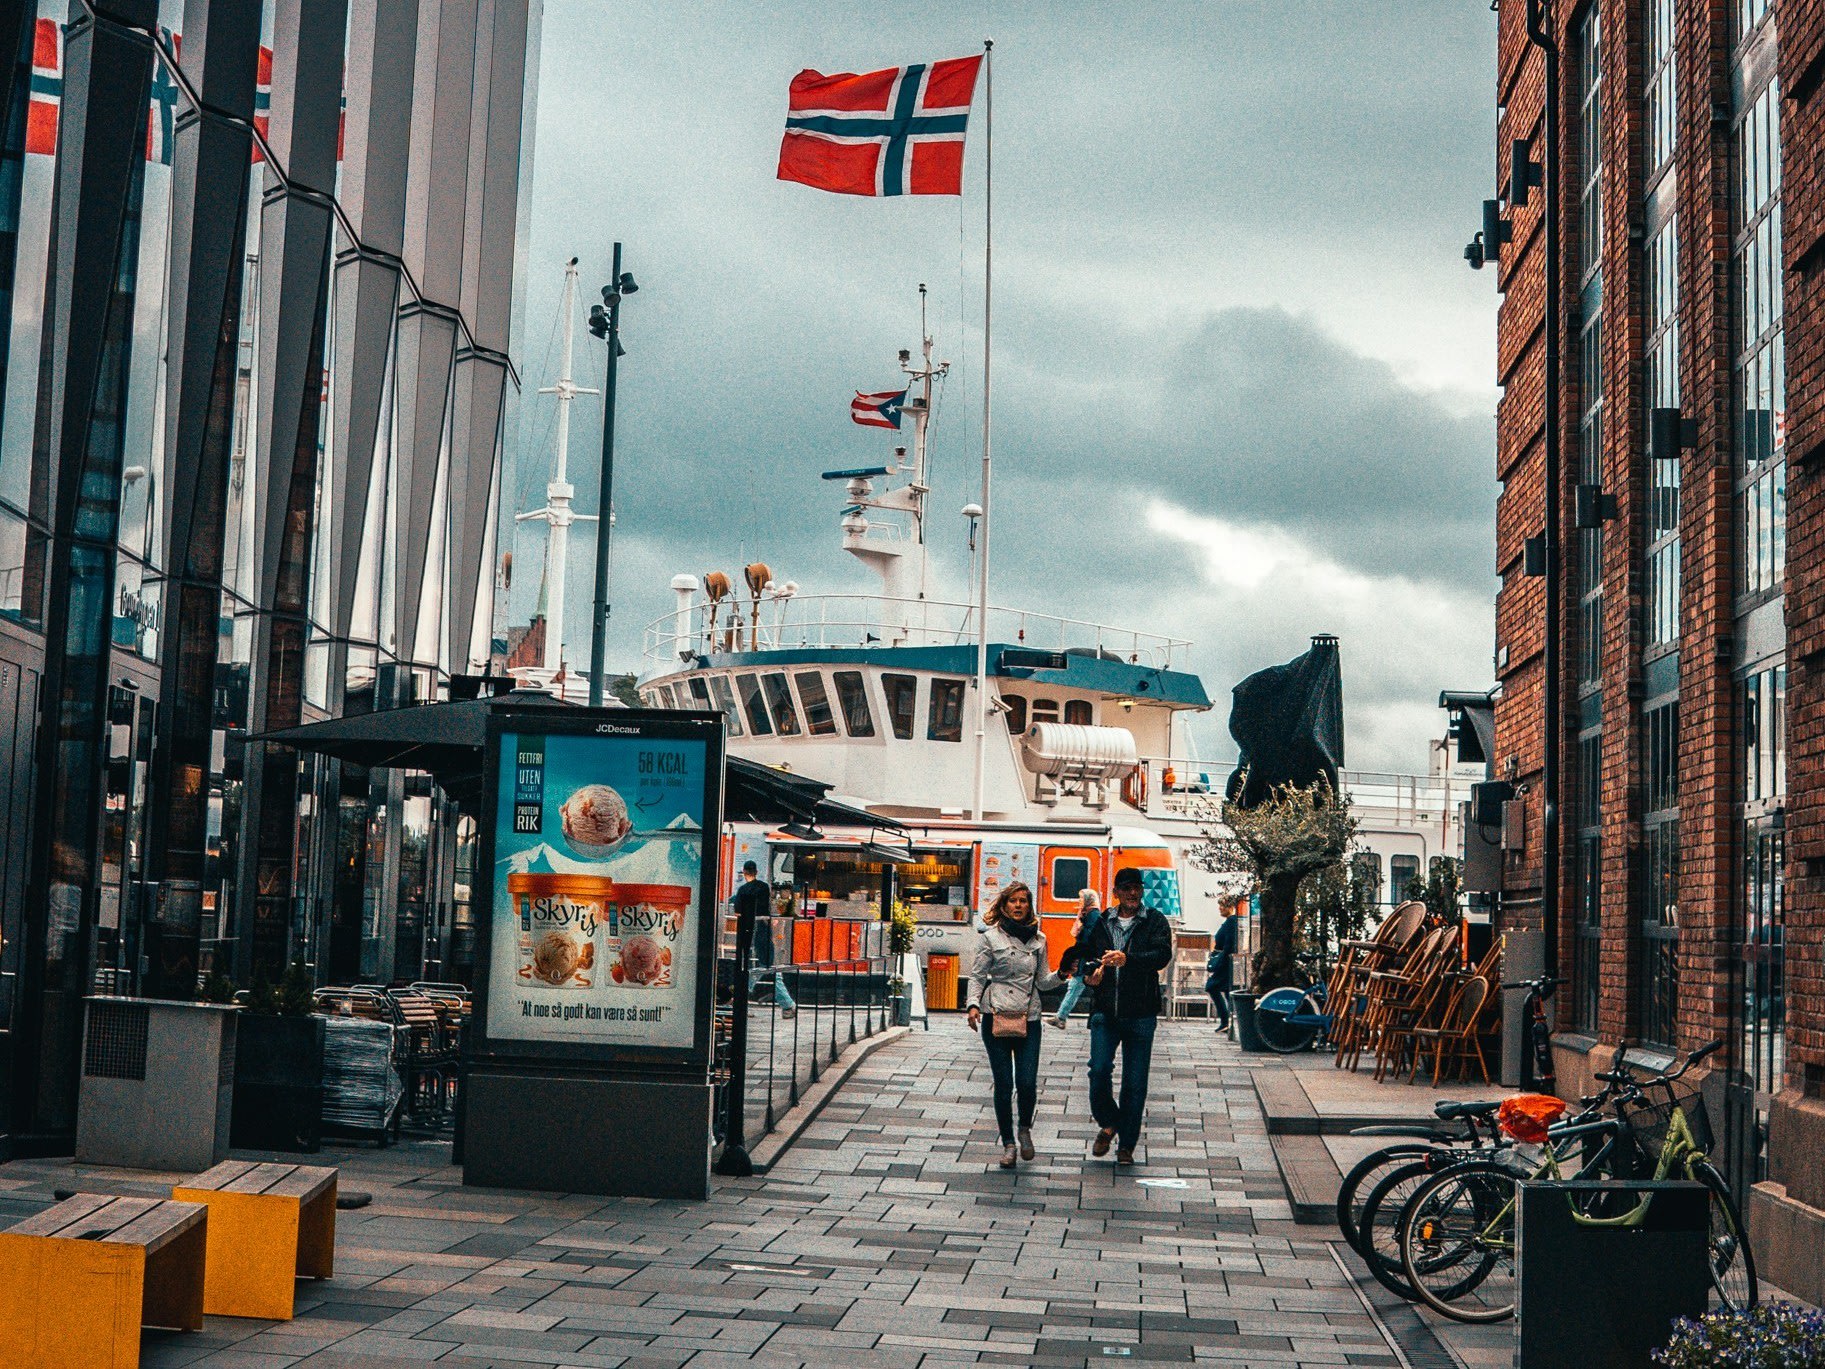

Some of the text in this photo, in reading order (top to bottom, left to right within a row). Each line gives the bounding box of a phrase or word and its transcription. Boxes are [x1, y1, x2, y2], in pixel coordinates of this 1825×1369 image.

[596, 724, 640, 734] JCDecaux
[518, 752, 543, 765] FETTFRI
[638, 751, 688, 775] 58 KCAL
[519, 769, 541, 785] UTEN
[517, 792, 541, 800] SUKKER
[517, 805, 539, 816] PROTEIN
[517, 815, 538, 831] RIK
[534, 897, 585, 926] Skyr
[620, 905, 668, 931] Skyr
[916, 928, 944, 938] OOD
[534, 1004, 550, 1018] noe
[551, 1001, 562, 1018] så
[563, 1002, 583, 1021] godt
[585, 1003, 602, 1020] kan
[603, 1007, 625, 1021] være
[626, 1004, 638, 1021] så
